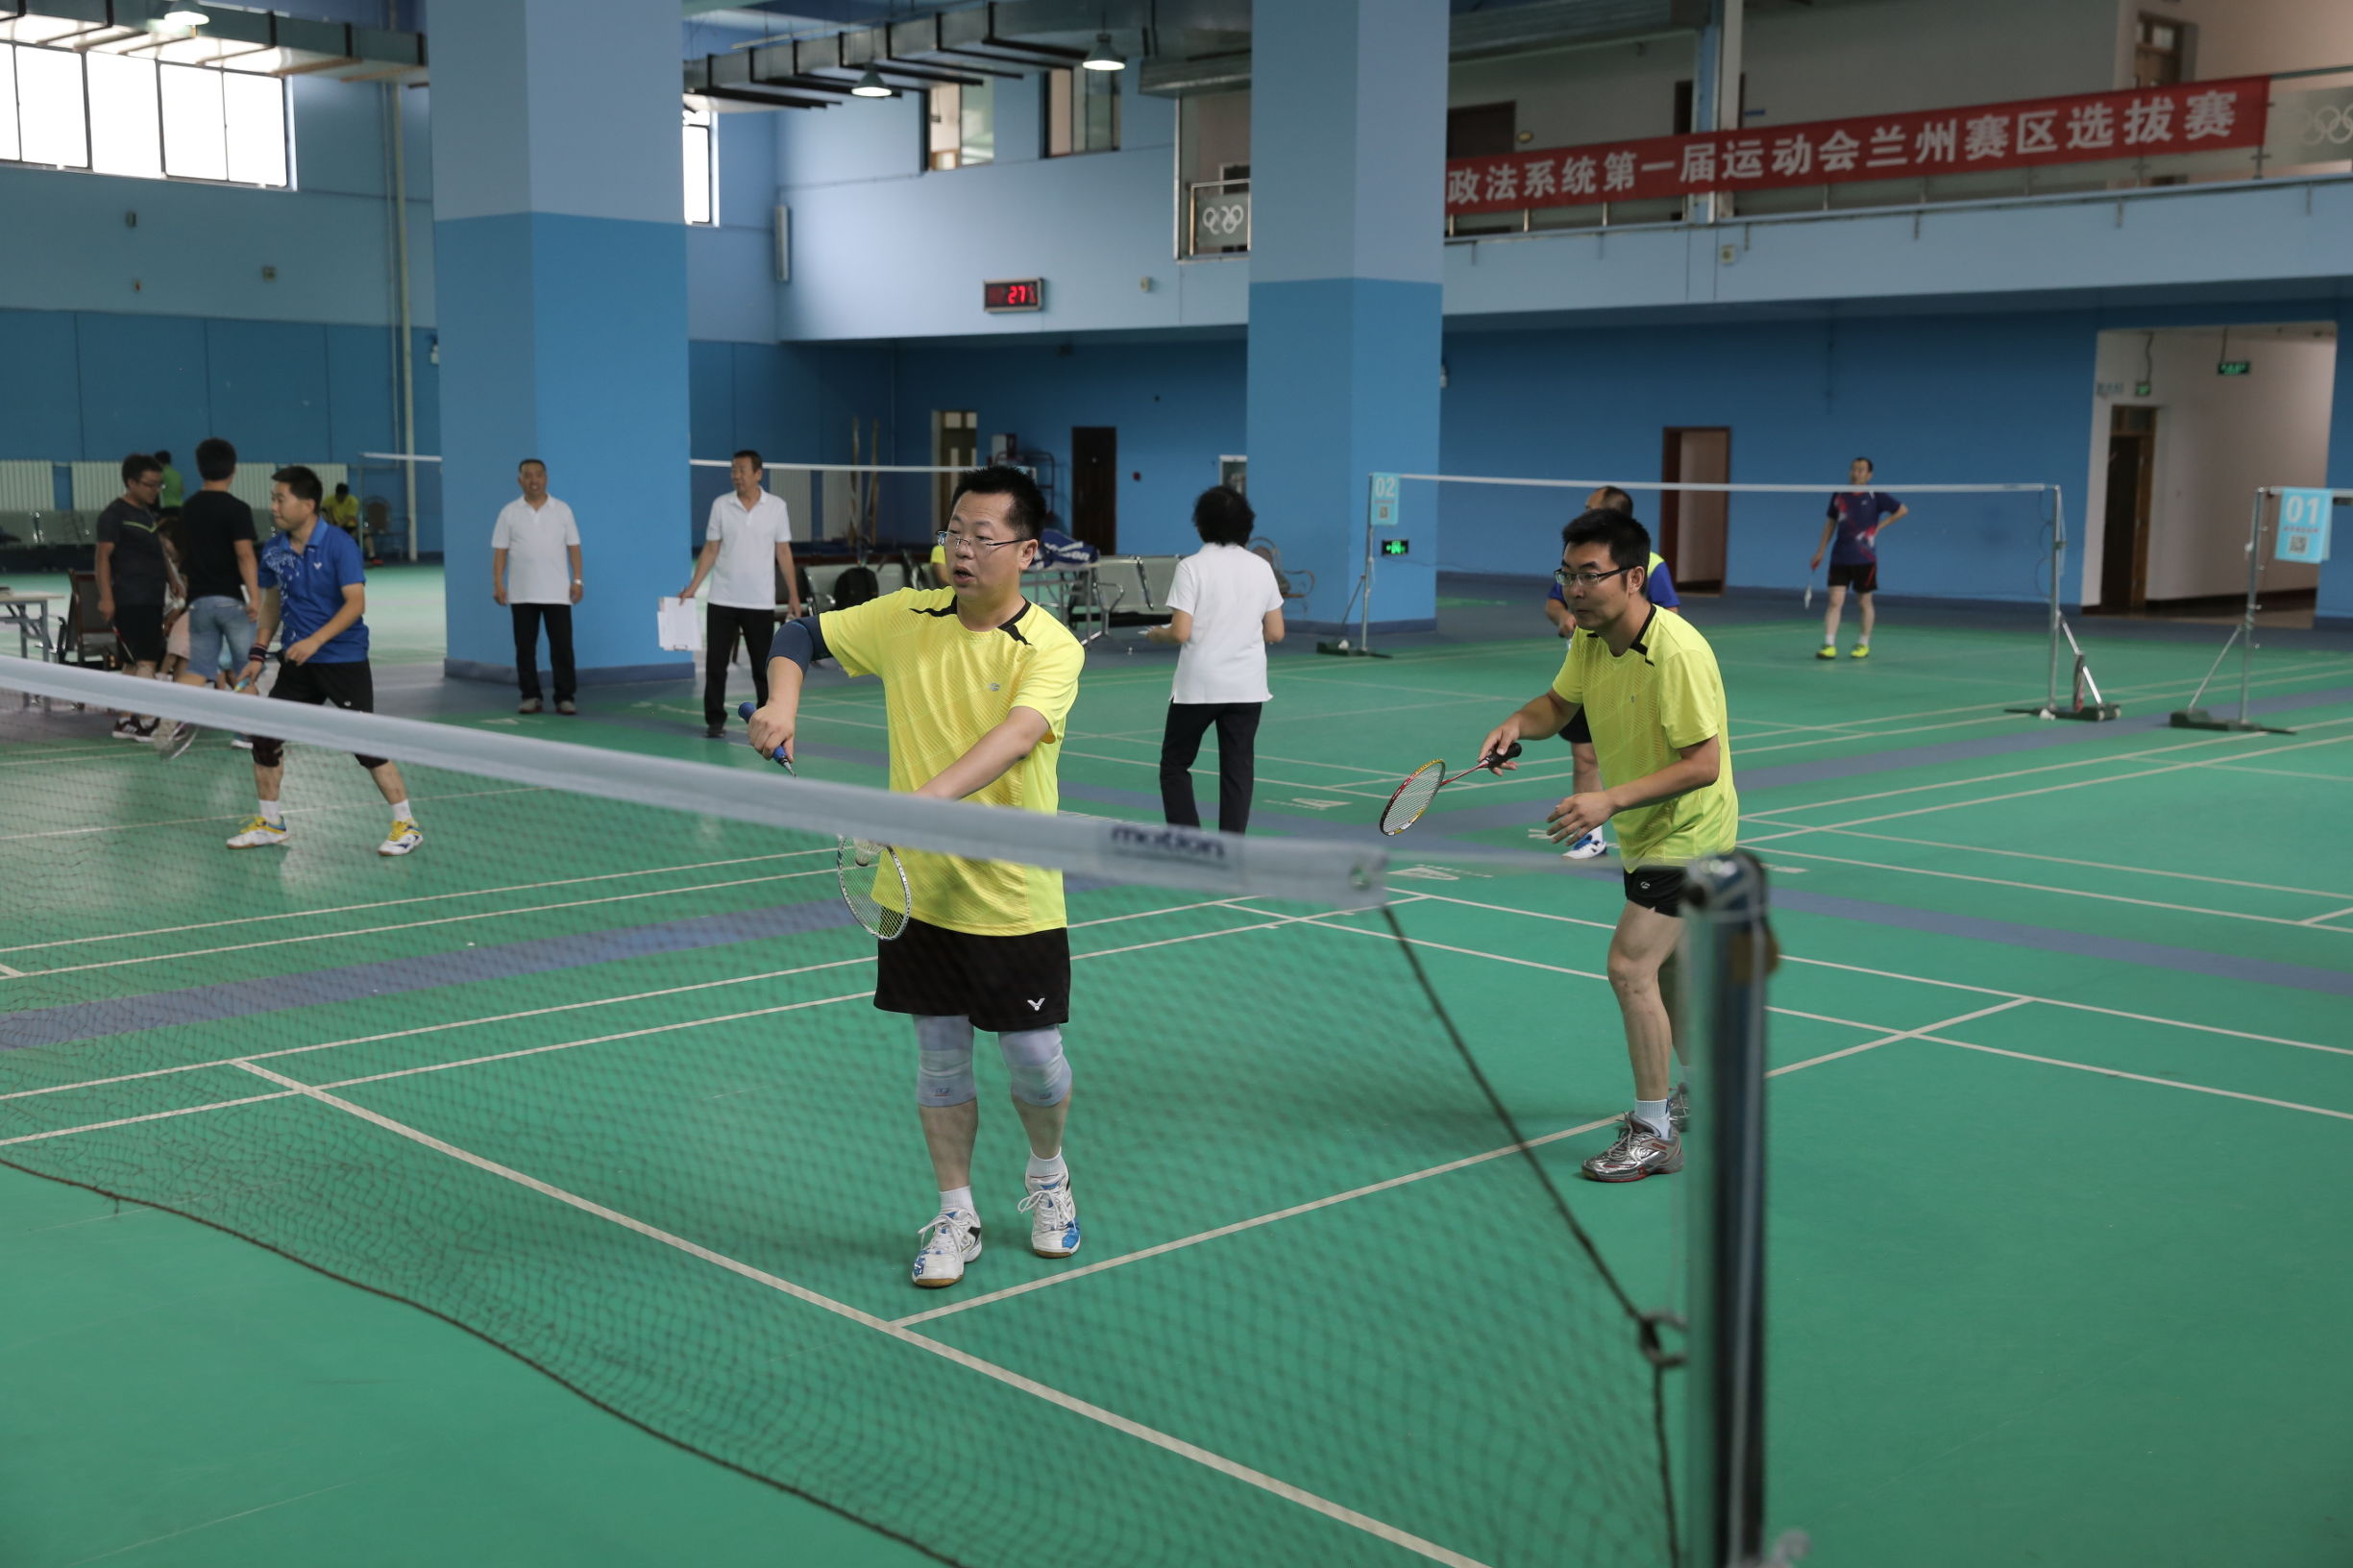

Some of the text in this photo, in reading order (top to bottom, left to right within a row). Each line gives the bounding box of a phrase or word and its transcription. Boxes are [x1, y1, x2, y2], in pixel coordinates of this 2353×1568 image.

[1447, 90, 2237, 206] 政法系统第一届运动会兰州赛区选拔赛
[1375, 476, 1396, 498] 02
[2286, 495, 2320, 526] 01
